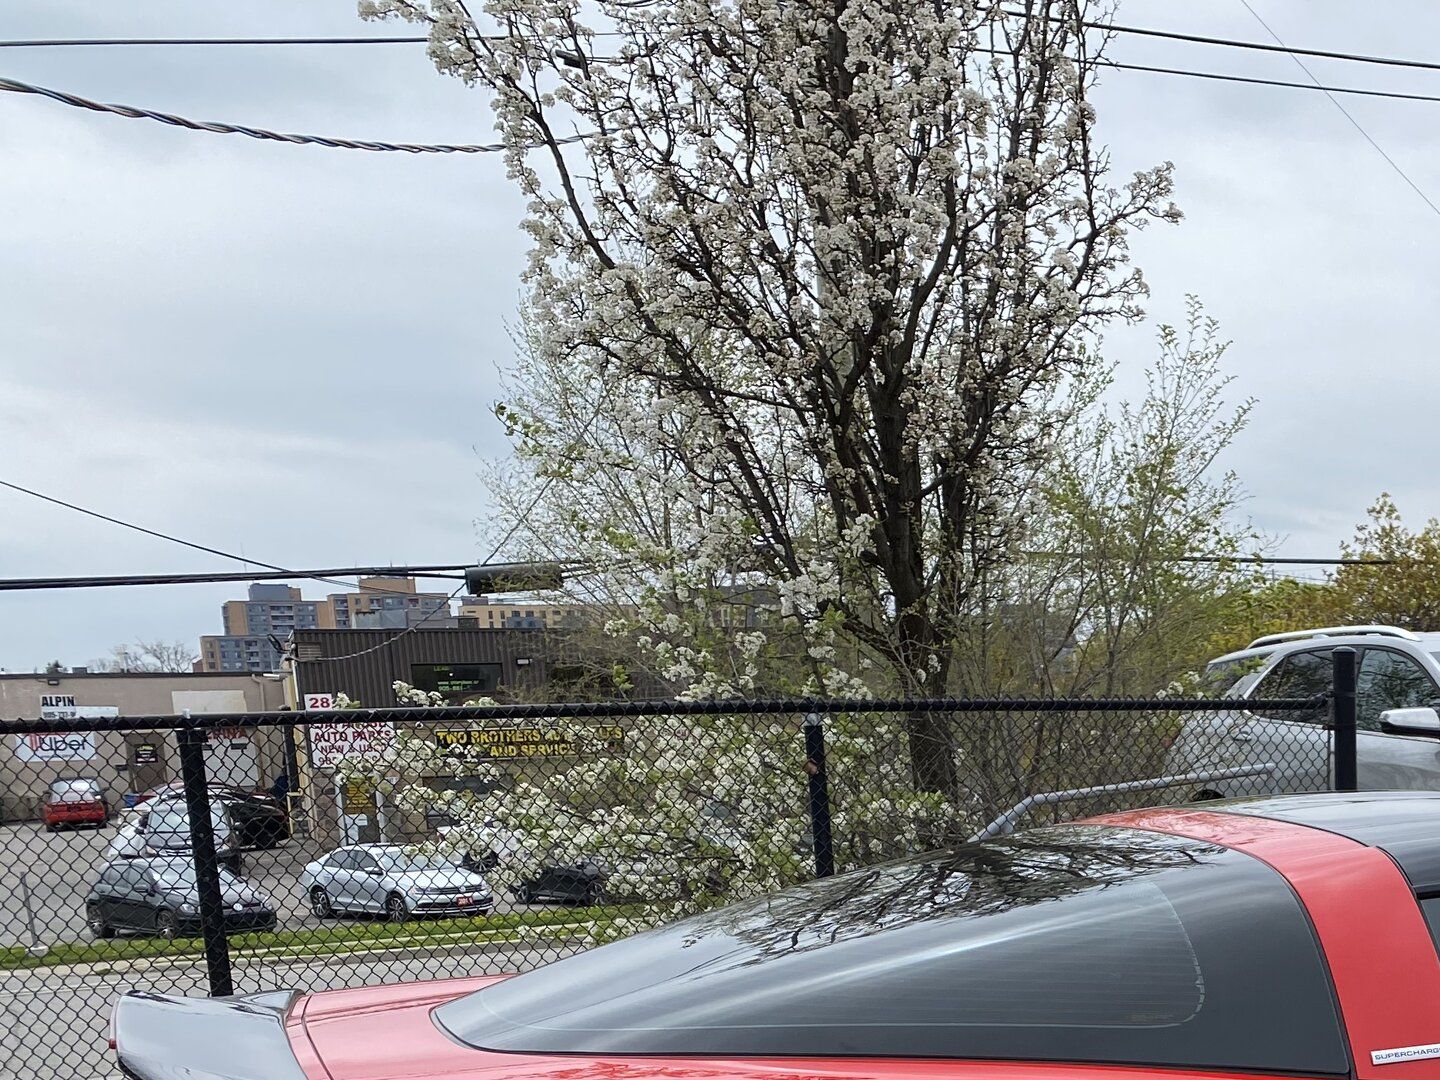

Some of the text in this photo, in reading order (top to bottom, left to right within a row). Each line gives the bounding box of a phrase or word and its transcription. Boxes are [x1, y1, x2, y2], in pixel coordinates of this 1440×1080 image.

[41, 696, 75, 706] ALPIN
[309, 697, 330, 708] 28
[314, 731, 347, 742] AUTO
[437, 732, 467, 744] TWO
[471, 730, 541, 744] BROTHERS
[489, 744, 517, 757] AND
